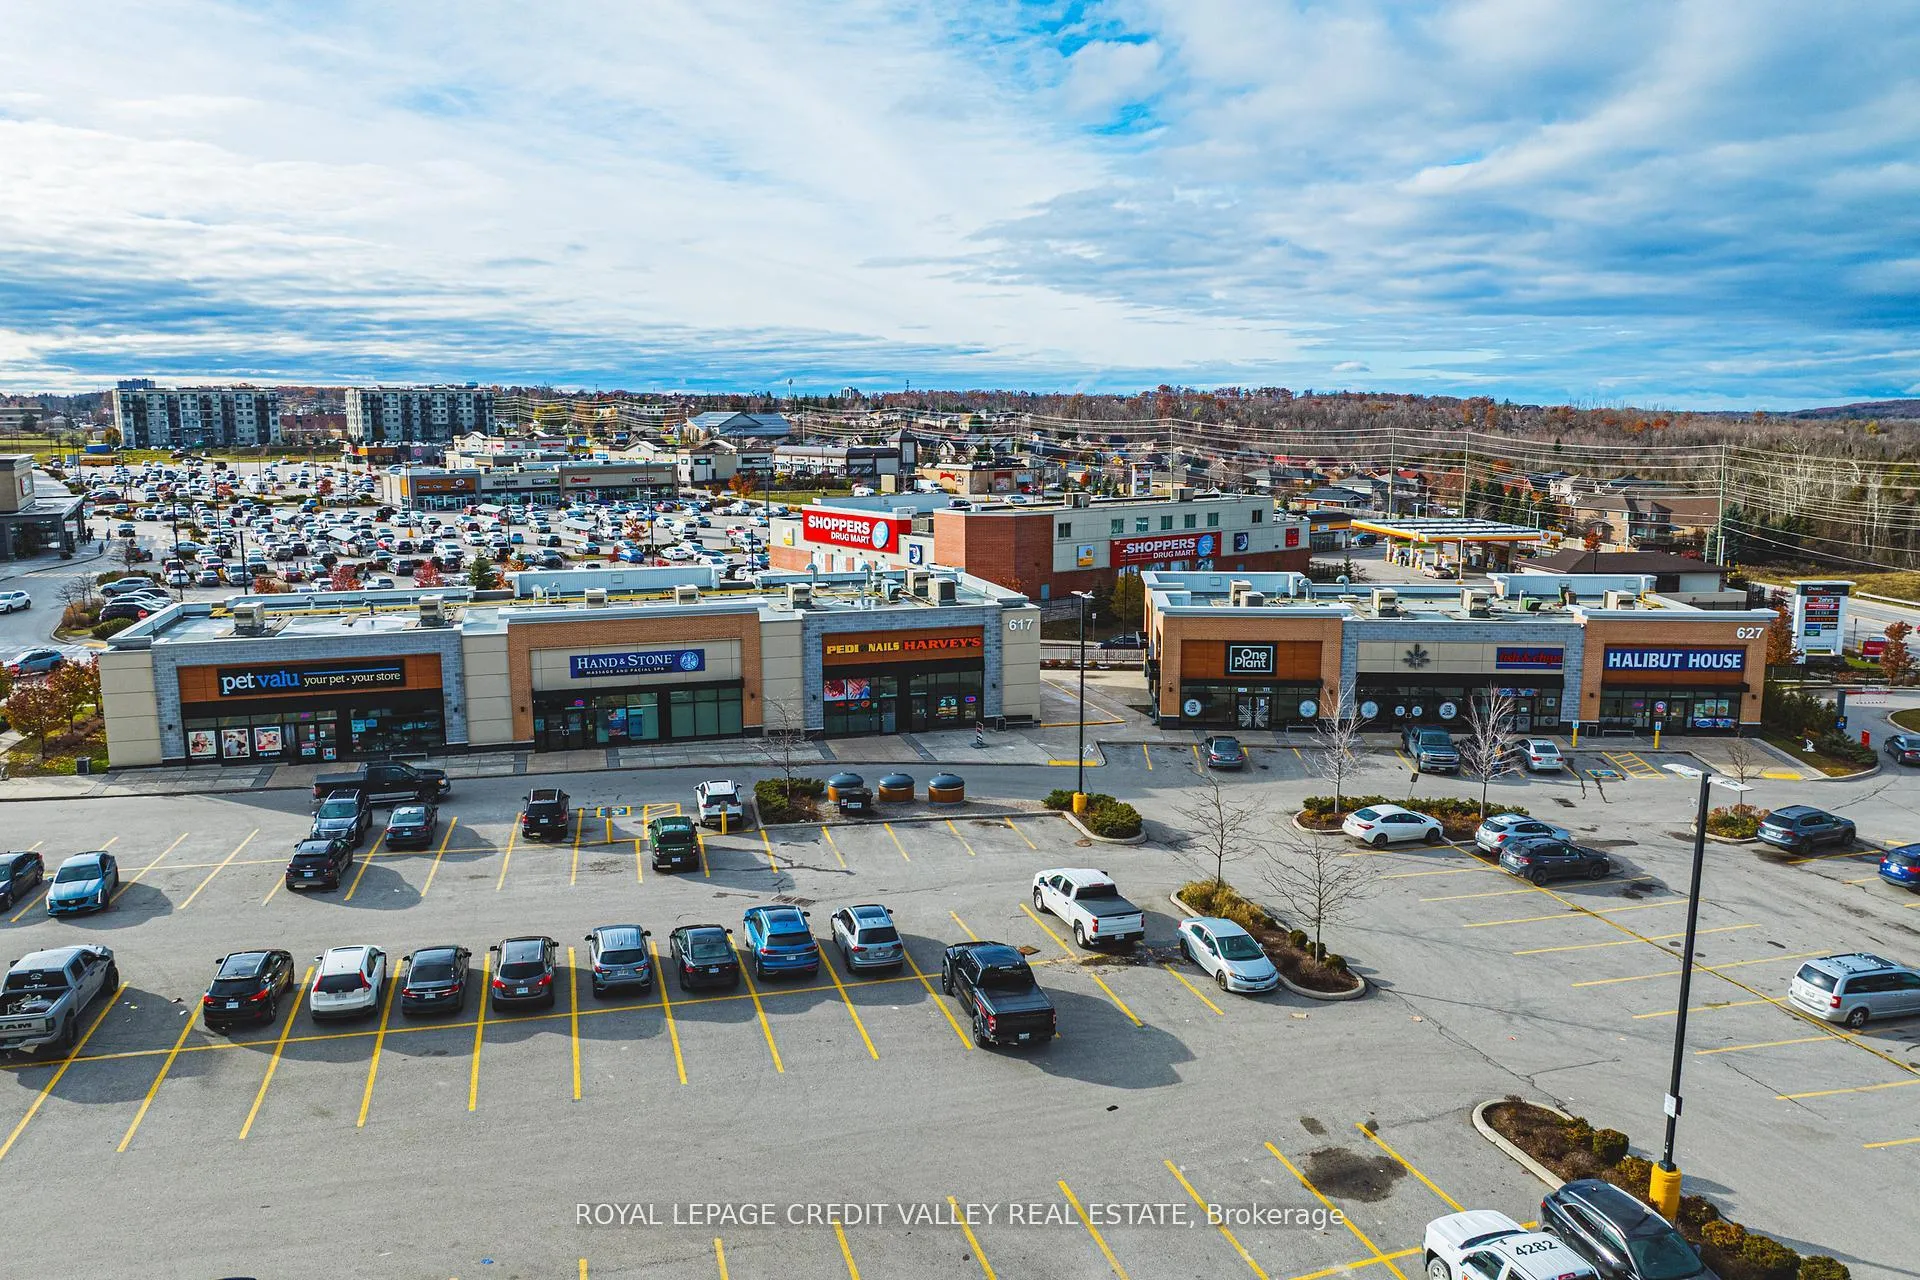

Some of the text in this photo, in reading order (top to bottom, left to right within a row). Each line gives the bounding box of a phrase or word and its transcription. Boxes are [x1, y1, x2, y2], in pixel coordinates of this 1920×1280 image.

[808, 515, 871, 535] SHOPPERS
[831, 531, 870, 544] DRUG MART
[1126, 538, 1195, 553] SHOPPERS
[1153, 549, 1194, 559] DRUG MART
[1009, 619, 1033, 631] 617
[1736, 627, 1764, 639] 627
[826, 644, 859, 654] PEDI
[868, 641, 900, 652] NAILS
[903, 637, 981, 650] HARVEY'S
[1241, 648, 1267, 660] One
[1499, 651, 1520, 662] fish
[1533, 651, 1563, 666] chips
[1608, 653, 1742, 668] HALIBUT HOUSE
[577, 657, 618, 669] HAND
[628, 654, 673, 666] STONE
[1234, 657, 1266, 668] Plant
[221, 670, 401, 694] pet valu your pet your store
[1515, 1240, 1558, 1257] 4282
